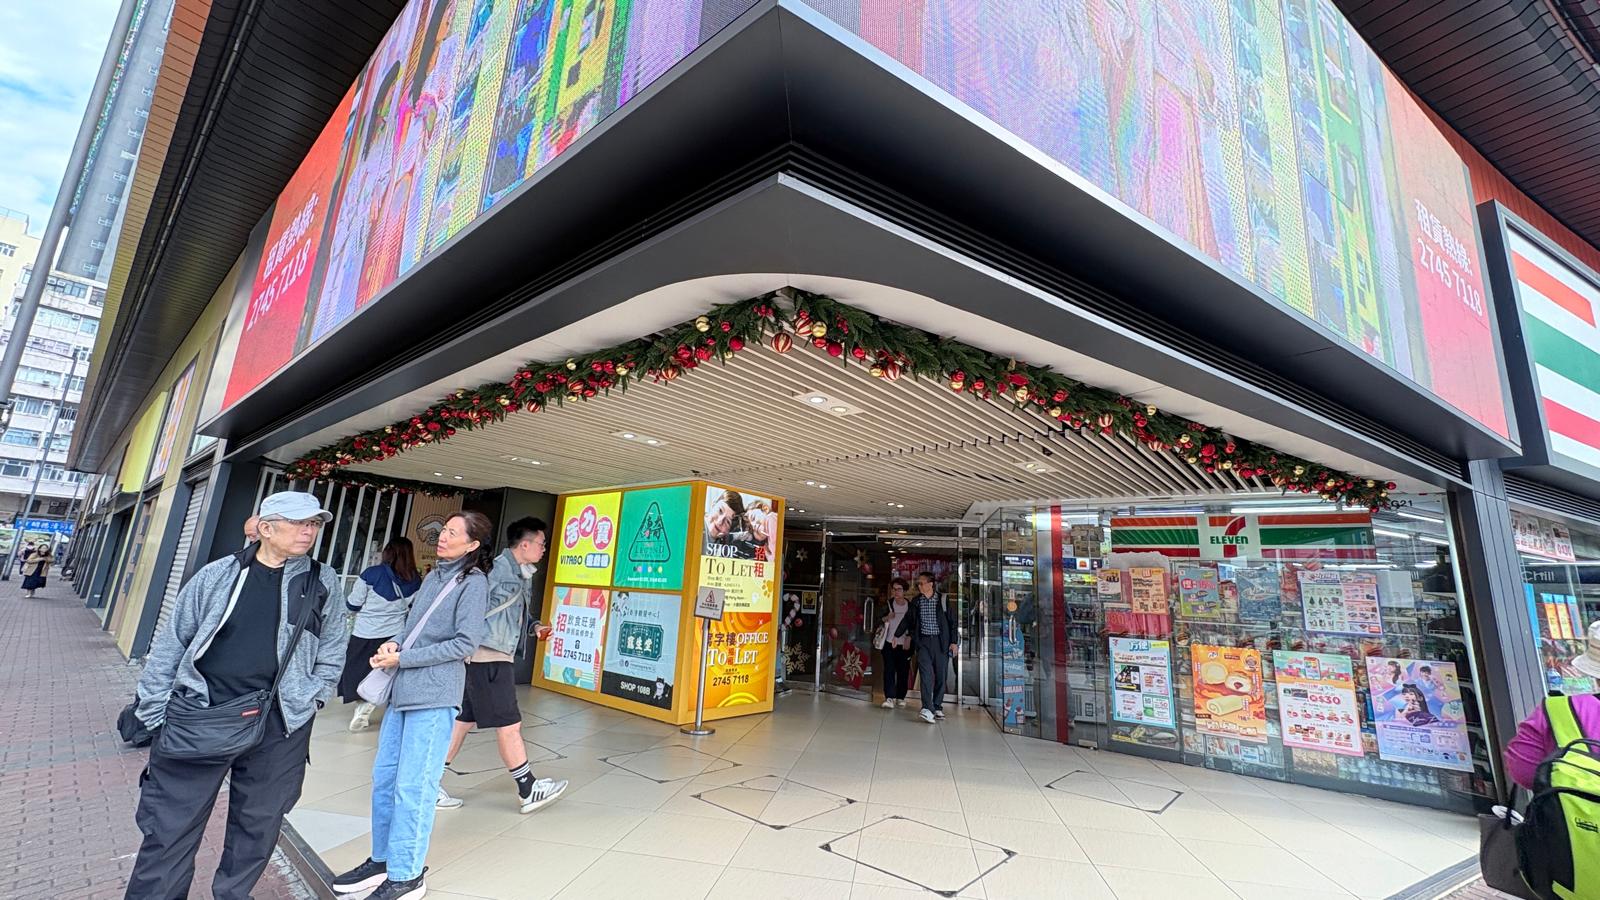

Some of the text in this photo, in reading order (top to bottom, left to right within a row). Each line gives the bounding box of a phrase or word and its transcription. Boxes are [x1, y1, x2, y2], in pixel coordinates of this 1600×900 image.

[1417, 237, 1483, 317] 2745 7118
[247, 238, 311, 331] 2745 7118
[705, 543, 738, 558] SHOP
[1521, 571, 1555, 582] Chill
[736, 632, 769, 645] OFFICE
[563, 649, 593, 663] 2745 7118
[620, 680, 635, 692] SHOP
[712, 674, 750, 687] 2745 7118
